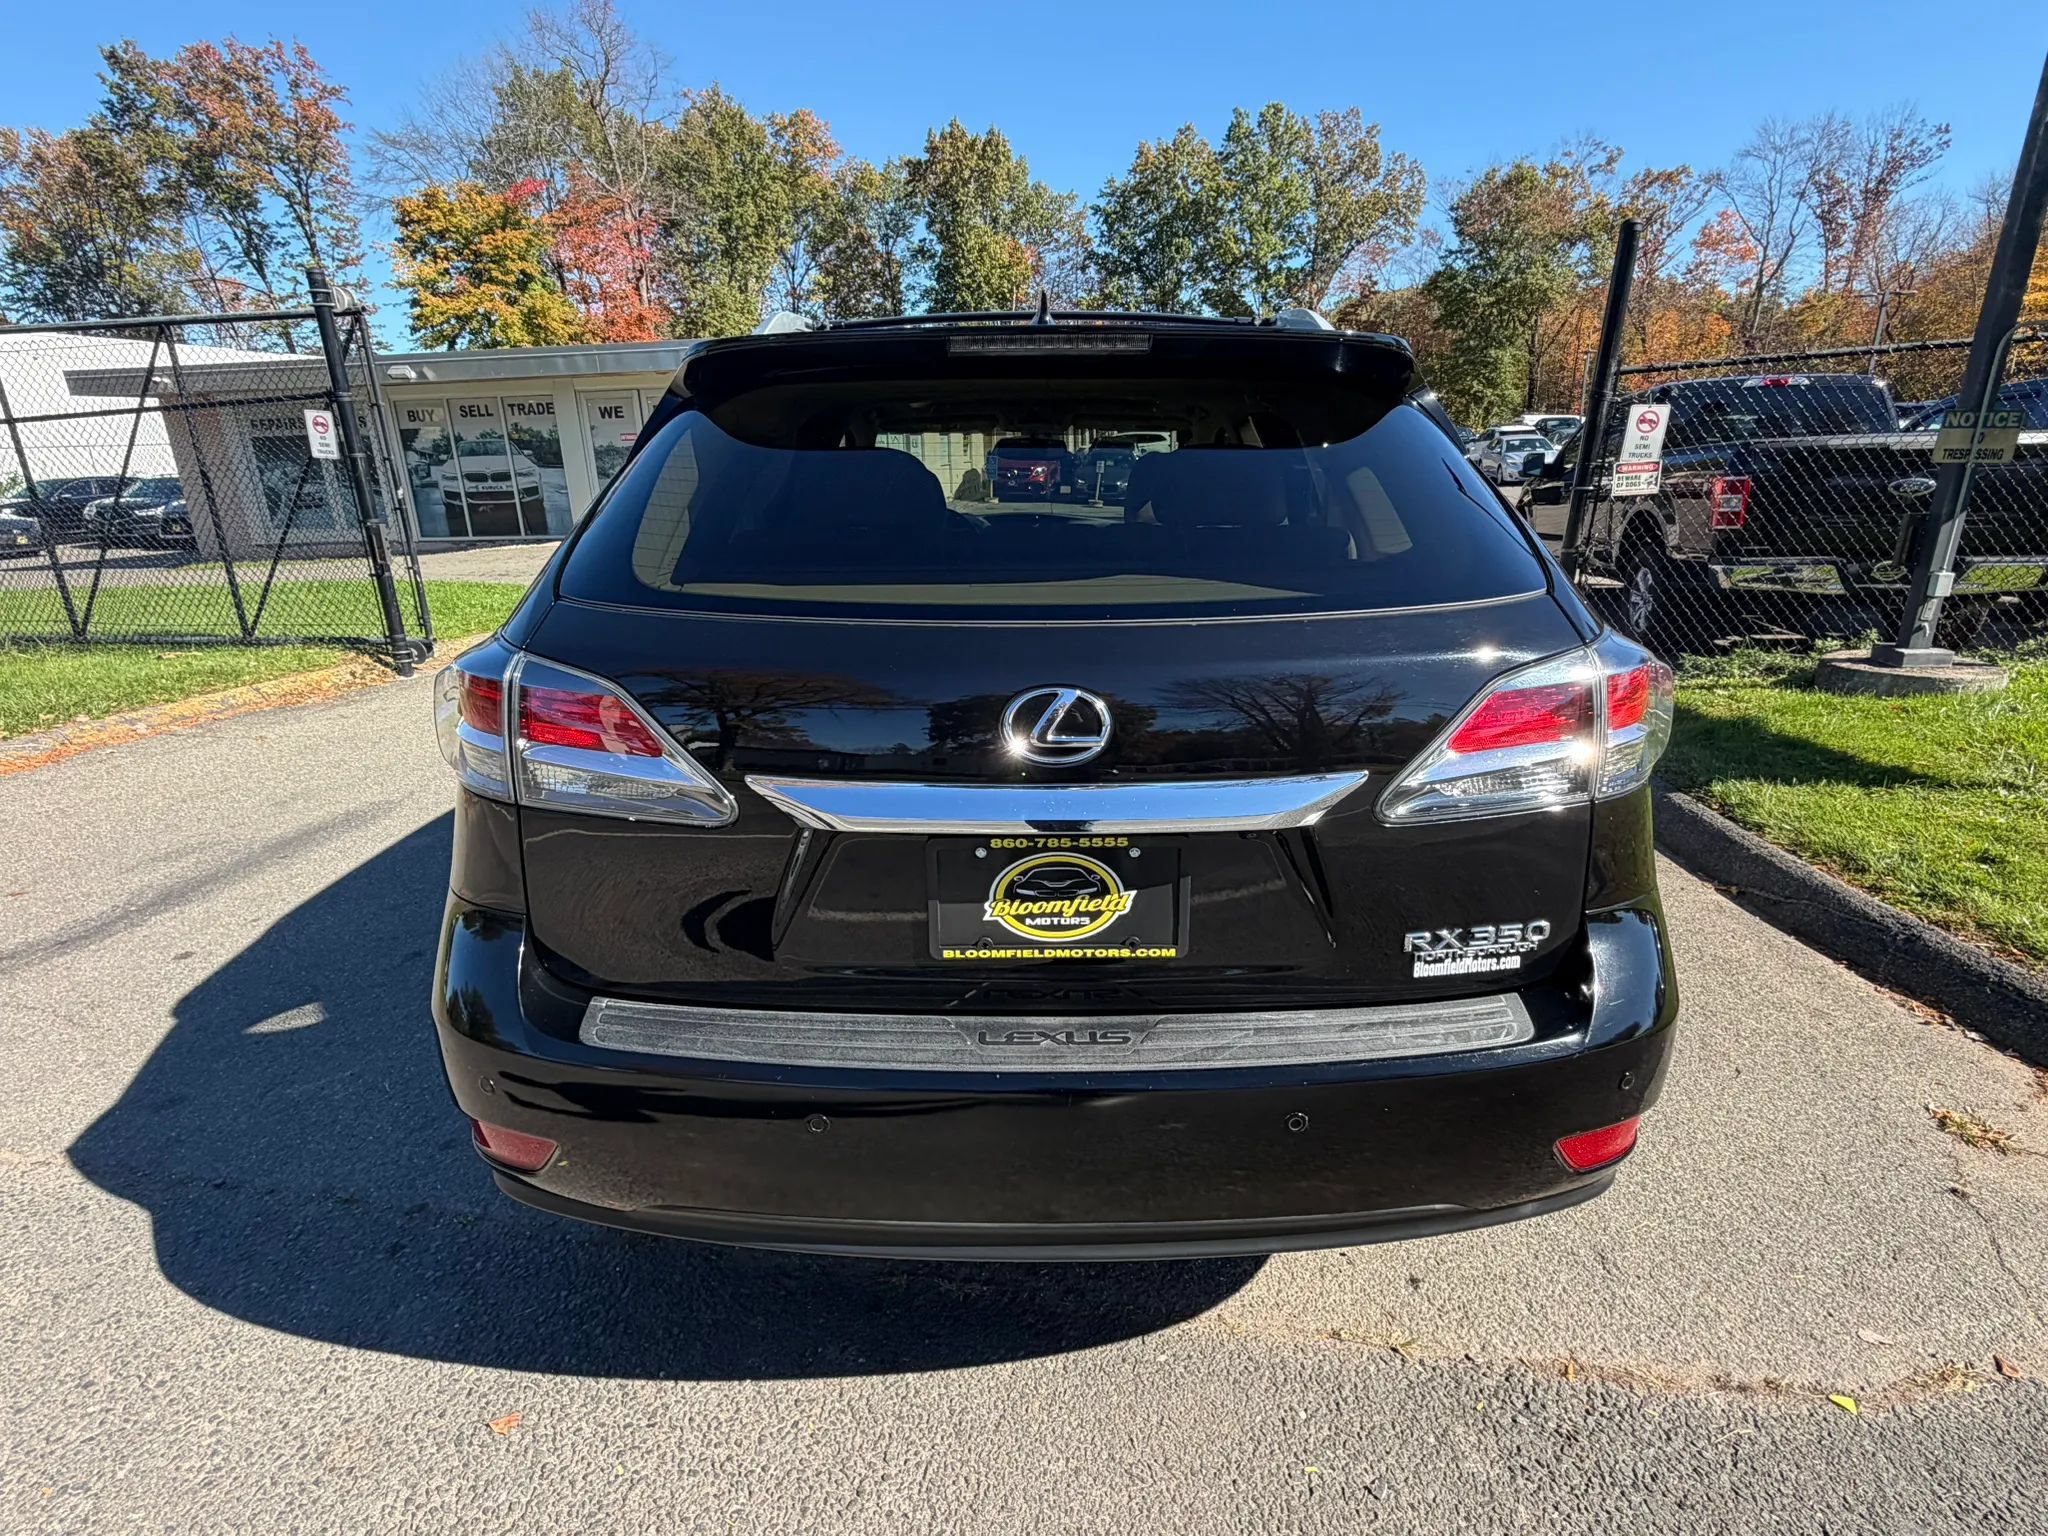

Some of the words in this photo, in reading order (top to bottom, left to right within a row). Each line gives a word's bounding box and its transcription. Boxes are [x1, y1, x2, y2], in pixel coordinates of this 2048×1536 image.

[459, 404, 494, 418] SELL
[507, 401, 555, 417] TRADE
[598, 406, 625, 419] WE
[407, 409, 435, 423] BUY
[1943, 448, 2004, 460] TRESPSSING
[1622, 463, 1653, 472] WARNING
[990, 838, 1129, 848] 860-785-5555
[991, 894, 1129, 918] Bloomfield
[1025, 917, 1091, 926] MOTORS
[943, 948, 1176, 959] BLOOMFIELDMOTORS.COM
[1413, 955, 1521, 978] BloomfieldMotors.com
[978, 1031, 1133, 1046] LEXUS
